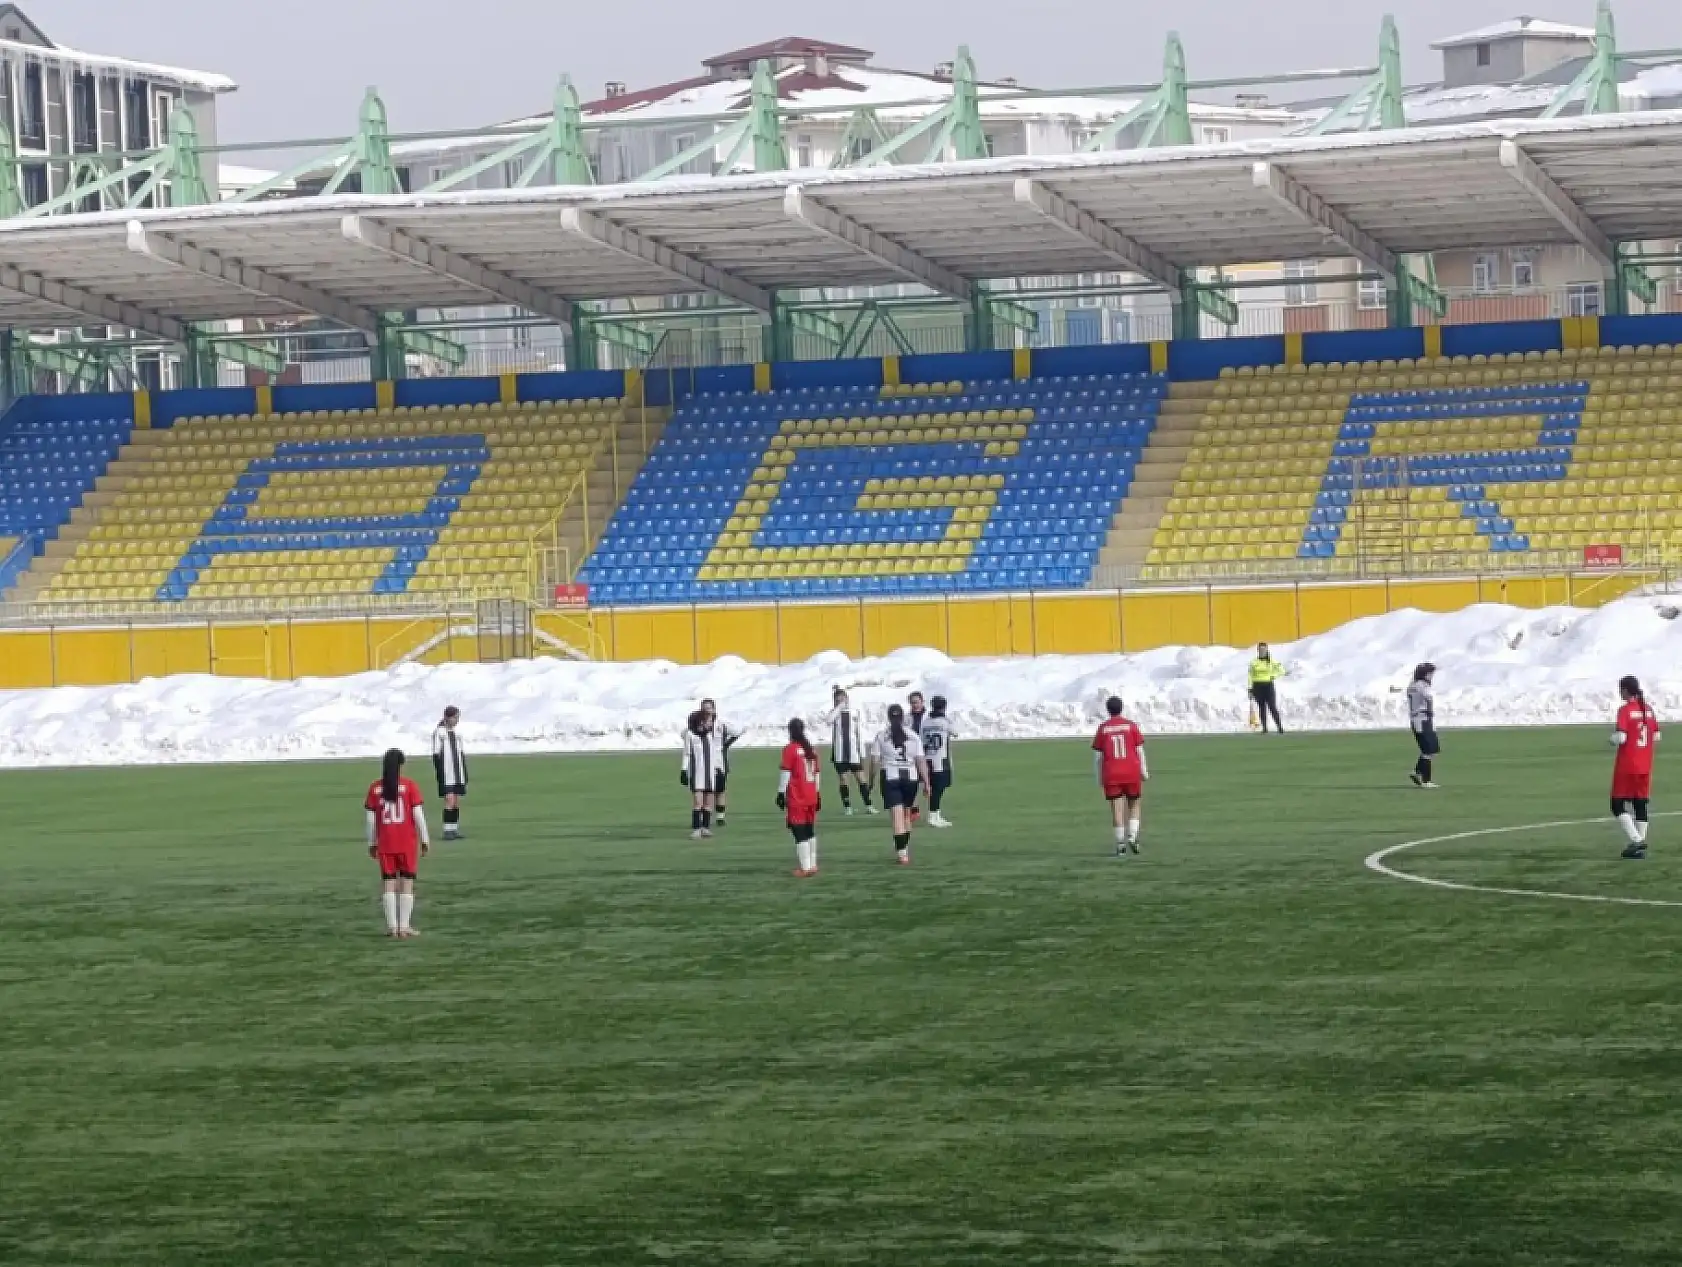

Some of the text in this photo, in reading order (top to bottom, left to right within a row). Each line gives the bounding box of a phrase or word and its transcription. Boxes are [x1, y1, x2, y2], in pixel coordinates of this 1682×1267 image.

[1110, 734, 1127, 759] 11
[1636, 722, 1648, 747] 3
[379, 796, 405, 824] 20
